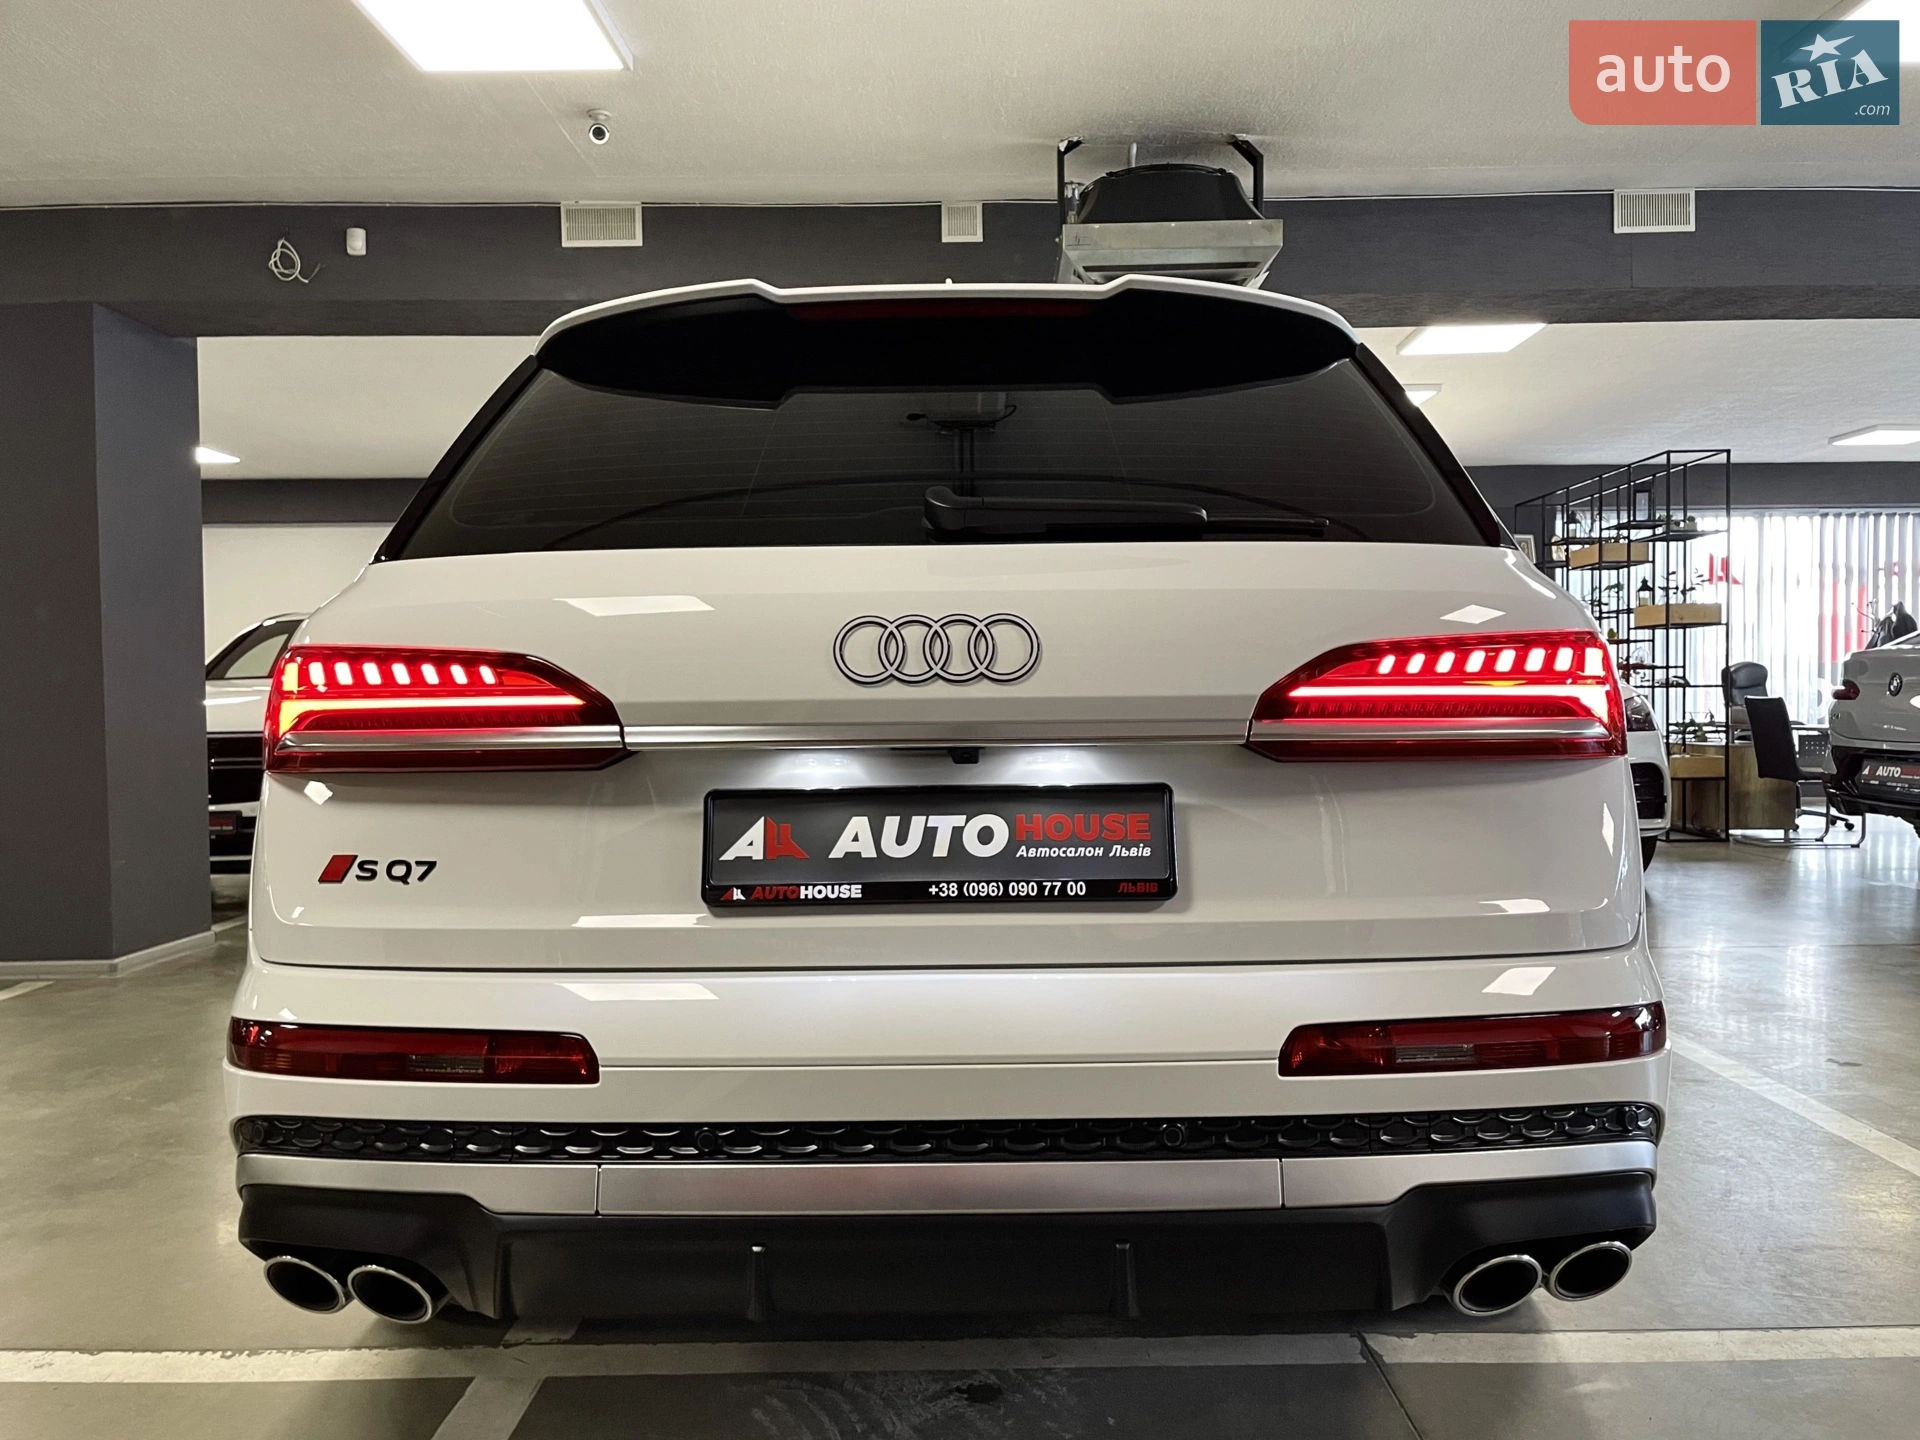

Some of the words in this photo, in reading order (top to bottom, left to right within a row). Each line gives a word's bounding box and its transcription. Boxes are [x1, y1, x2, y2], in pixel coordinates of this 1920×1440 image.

[1875, 765, 1902, 778] AUTO
[828, 813, 1010, 858] AUTO
[1015, 813, 1151, 841] HOUSE
[1016, 845, 1103, 858] Автосалон
[1109, 842, 1152, 858] Львів
[928, 883, 959, 897] +38
[962, 882, 1004, 897] (096)
[1008, 882, 1038, 896] 090
[1042, 882, 1062, 896] 77
[1066, 881, 1087, 896] 00
